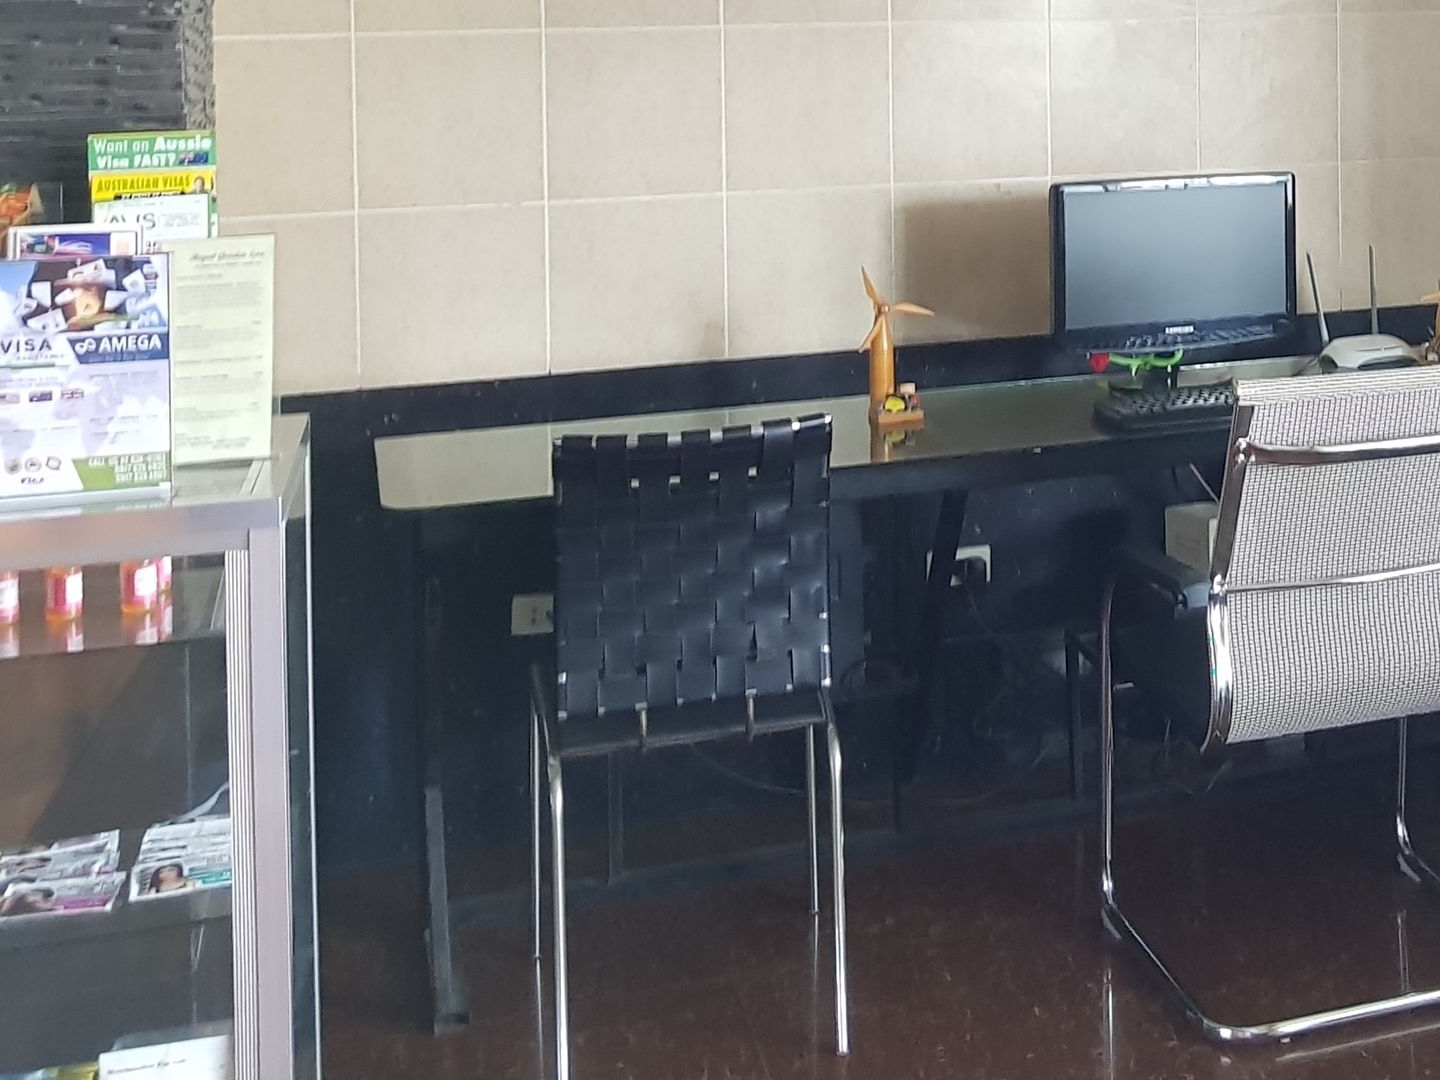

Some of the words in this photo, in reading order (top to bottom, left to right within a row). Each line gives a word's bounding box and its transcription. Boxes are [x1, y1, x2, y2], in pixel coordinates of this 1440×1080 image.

[94, 137, 127, 154] Want
[132, 141, 149, 153] an
[96, 154, 129, 169] Visa
[96, 176, 160, 192] AUSTRALIAN
[161, 174, 191, 189] VISAS
[0, 337, 52, 354] VISA
[99, 334, 161, 353] AMEGA
